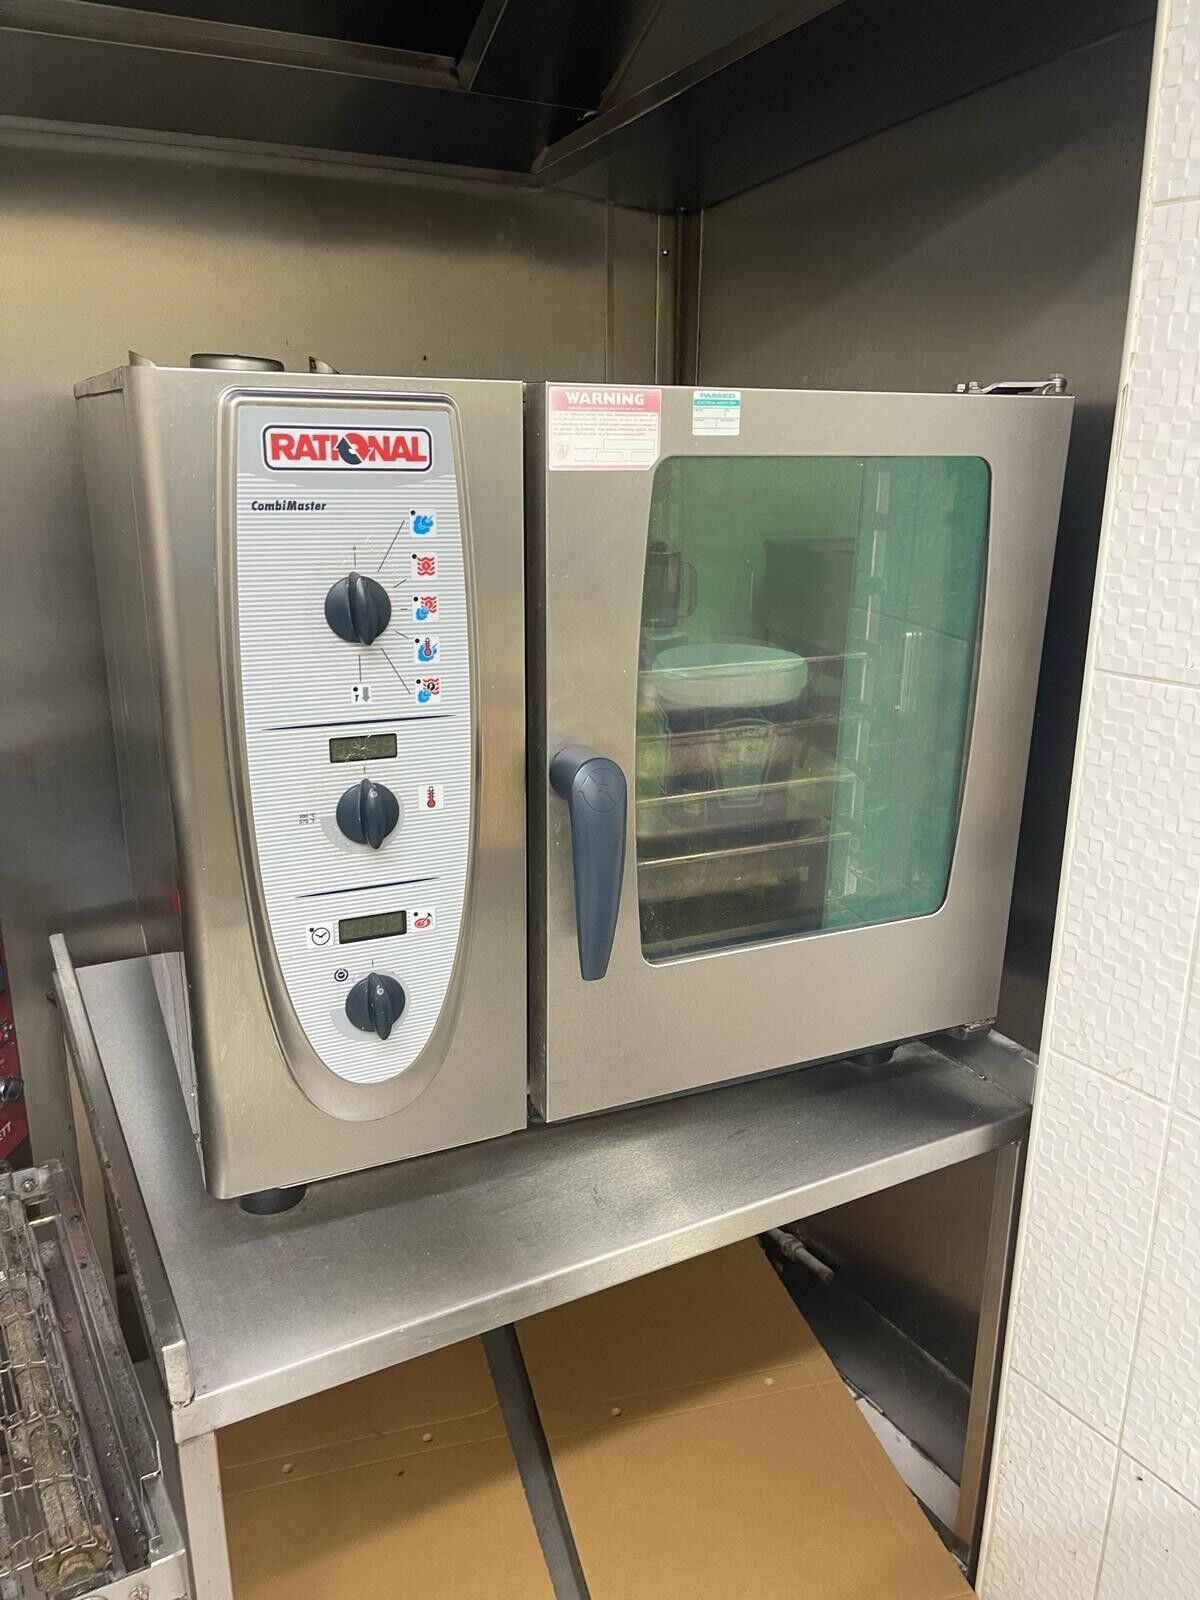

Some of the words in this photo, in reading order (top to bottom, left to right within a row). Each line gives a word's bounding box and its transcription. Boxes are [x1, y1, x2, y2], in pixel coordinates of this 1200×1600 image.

[565, 391, 645, 406] WARNING
[270, 432, 427, 465] RATIONAL
[251, 500, 327, 511] CombiMaster
